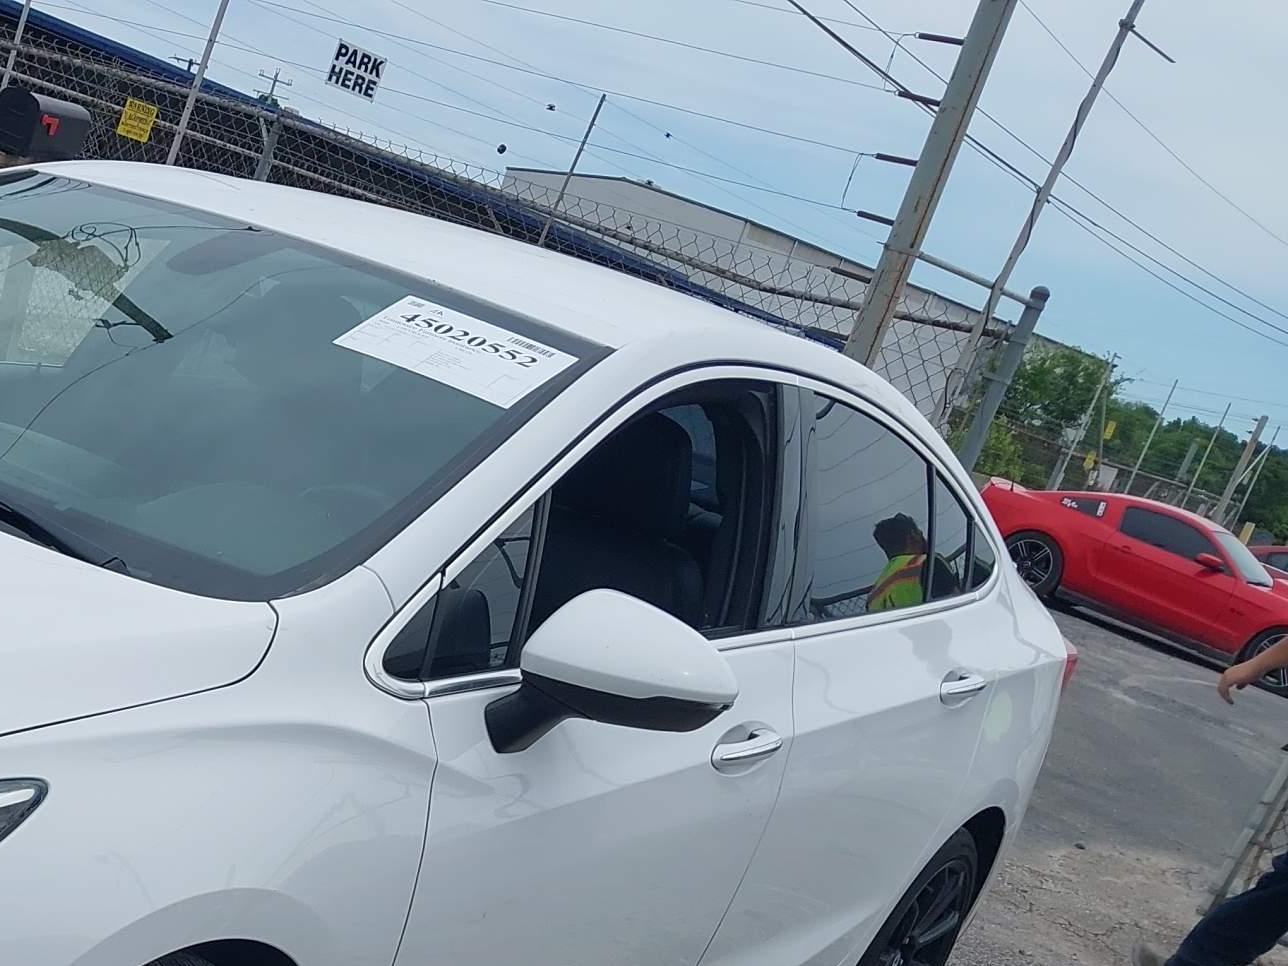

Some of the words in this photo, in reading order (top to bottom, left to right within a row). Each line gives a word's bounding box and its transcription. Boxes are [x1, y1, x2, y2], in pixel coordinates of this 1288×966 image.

[334, 42, 385, 79] PARK
[327, 63, 378, 98] HERE
[399, 313, 539, 368] 45020552
